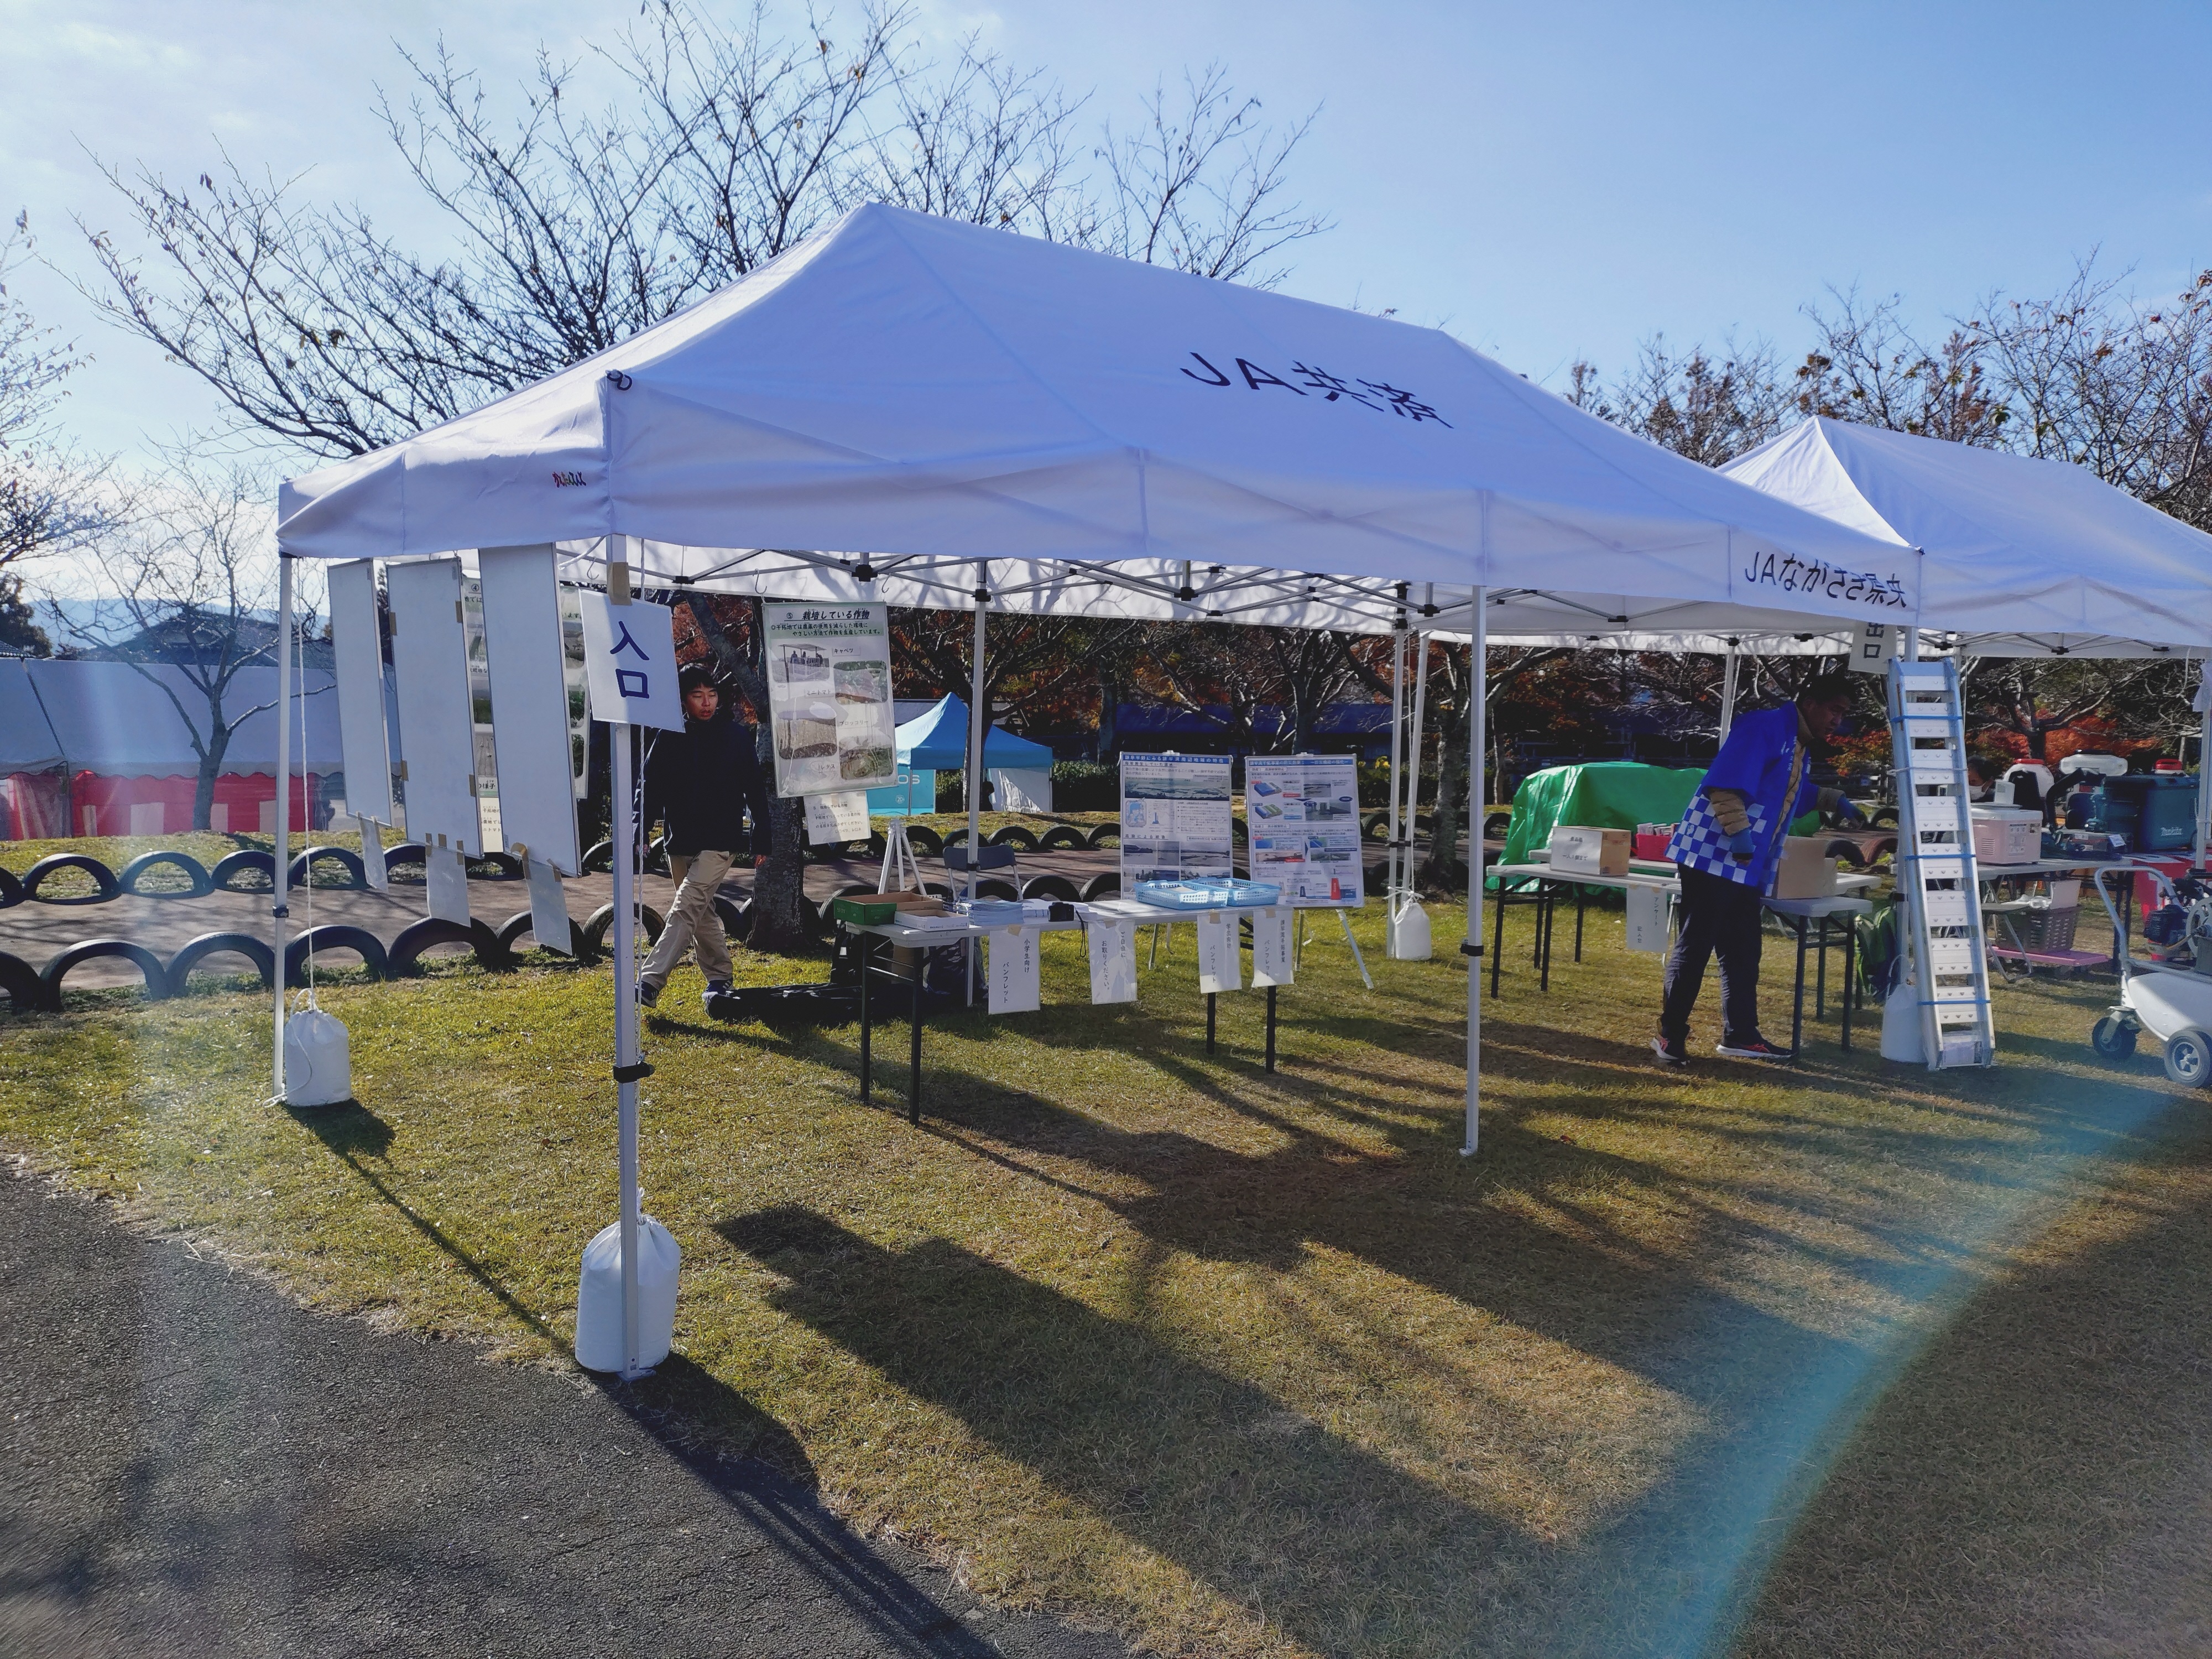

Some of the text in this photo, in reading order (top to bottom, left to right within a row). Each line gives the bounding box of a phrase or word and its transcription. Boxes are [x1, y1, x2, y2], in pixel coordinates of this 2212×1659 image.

[1180, 352, 1454, 429] JA共済
[1745, 551, 1906, 608] JAながさき県央
[801, 610, 870, 620] 栽培している作物
[1863, 622, 1885, 659] 出口
[609, 620, 650, 699] 入口
[1102, 940, 1110, 990] お取りください。
